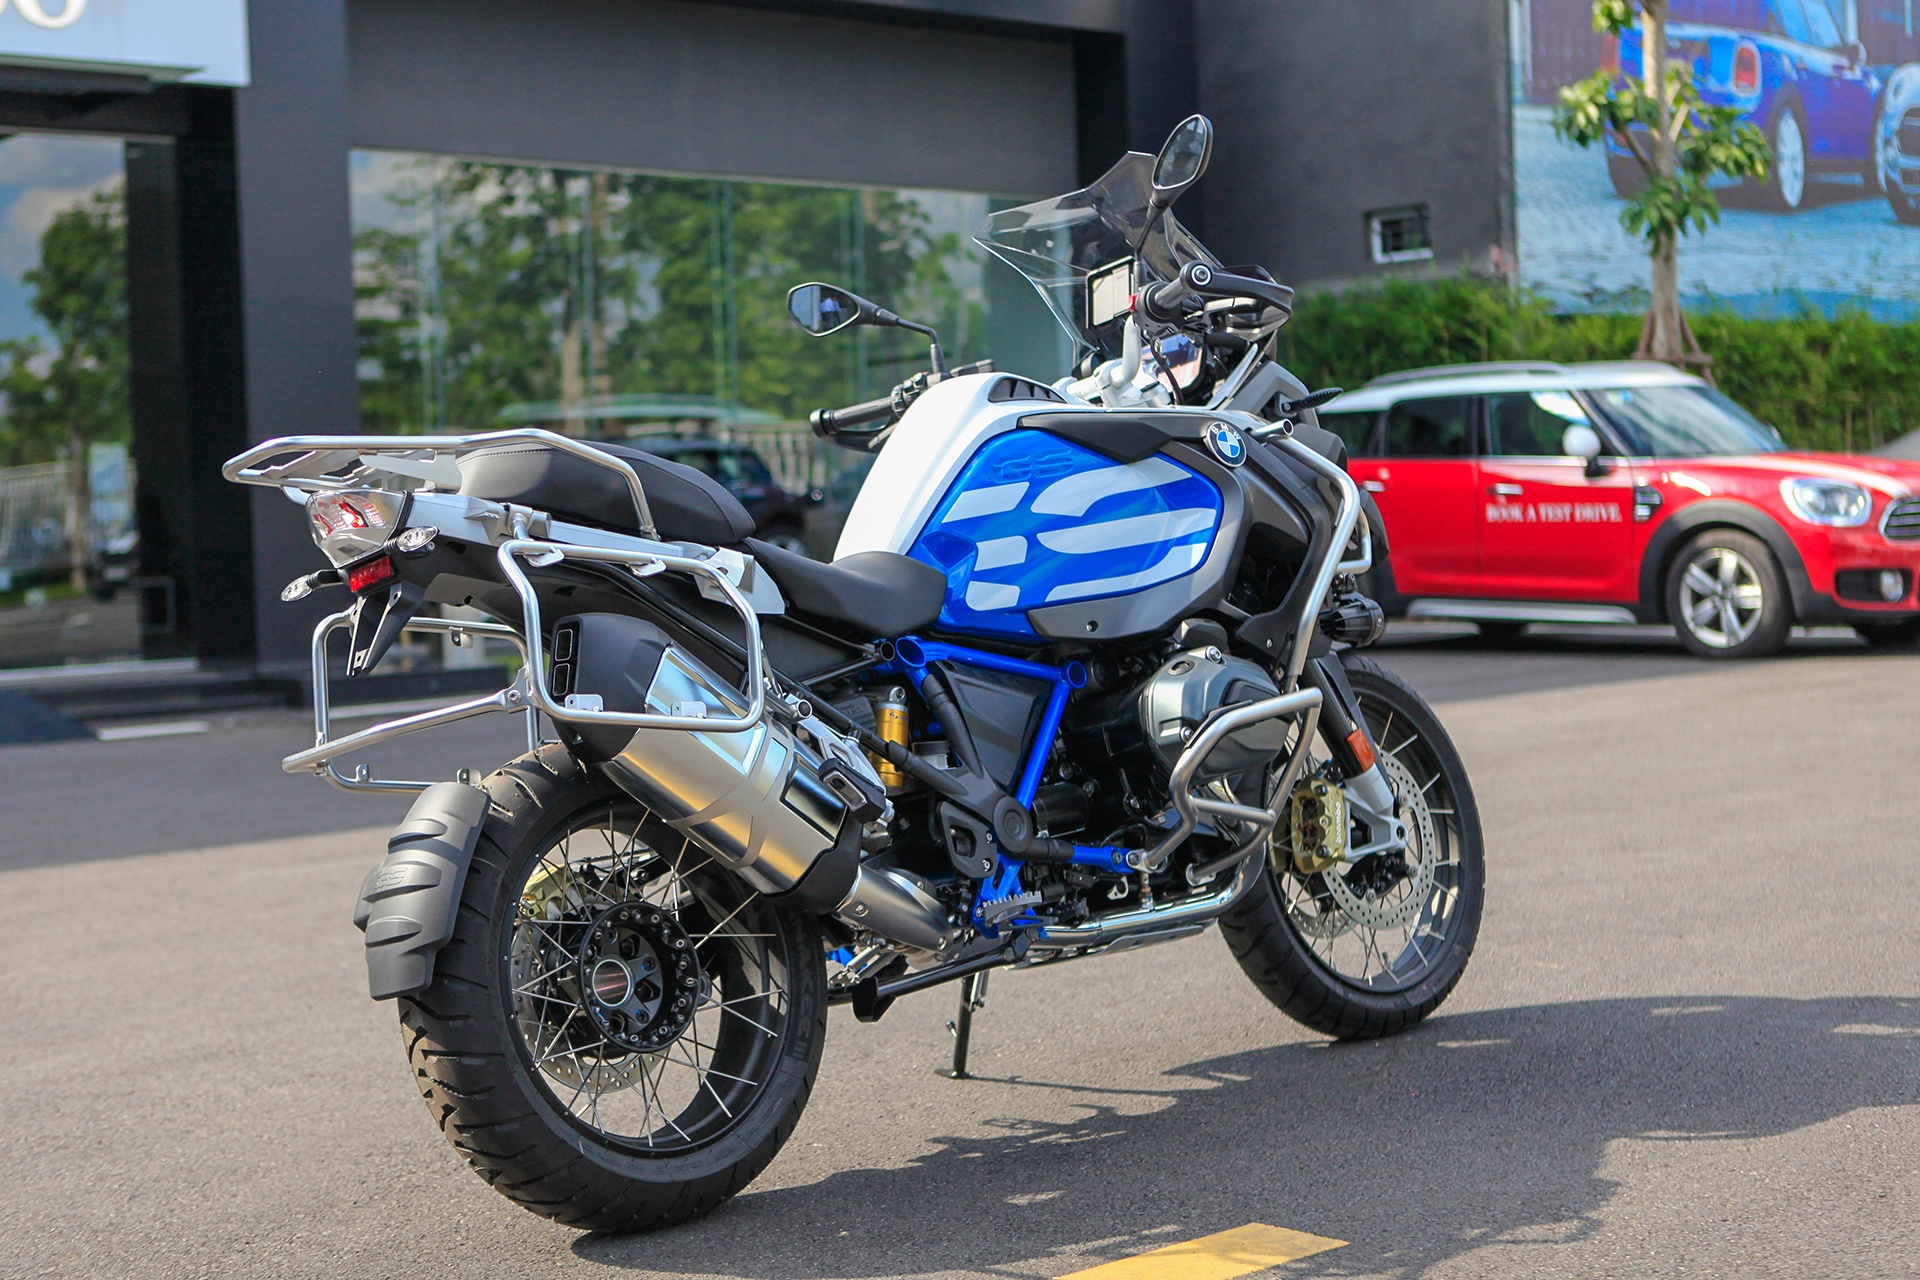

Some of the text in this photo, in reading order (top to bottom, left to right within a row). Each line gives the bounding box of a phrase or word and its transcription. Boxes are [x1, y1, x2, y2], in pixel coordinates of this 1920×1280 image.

[989, 449, 1074, 484] GS
[1485, 502, 1524, 523] BOOK
[1525, 502, 1537, 523] A
[1537, 502, 1573, 523] TEST
[1334, 801, 1342, 844] brembo
